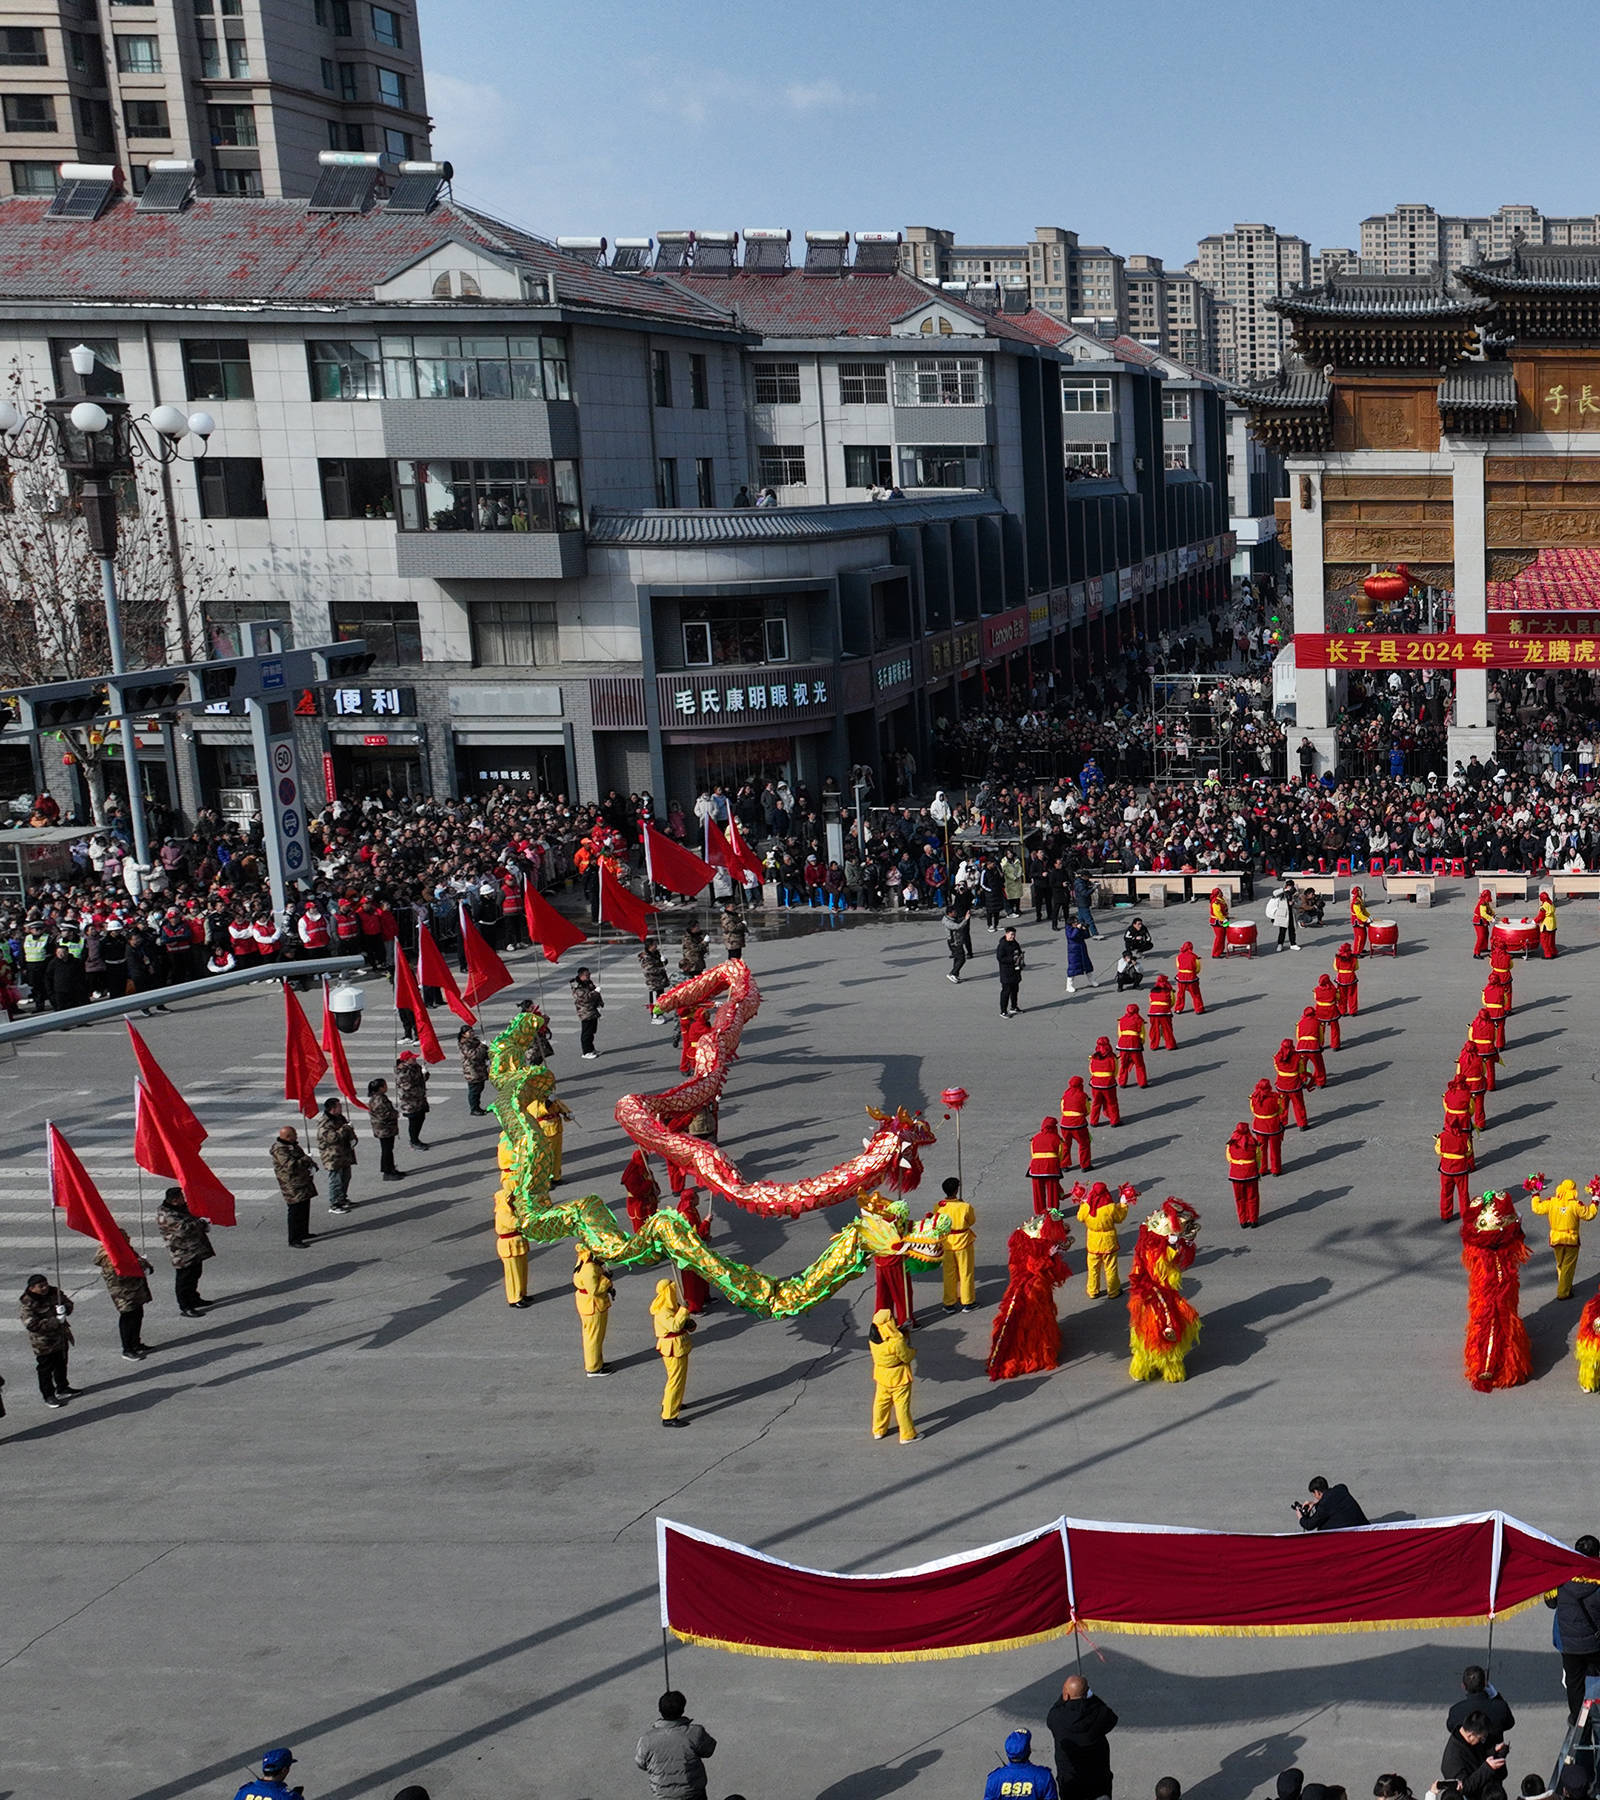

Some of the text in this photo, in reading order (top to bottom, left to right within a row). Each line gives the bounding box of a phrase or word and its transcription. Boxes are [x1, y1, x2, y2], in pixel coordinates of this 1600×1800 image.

[333, 688, 401, 715] 便利
[675, 681, 828, 715] 毛氏康明眼视光
[278, 753, 289, 767] 50
[1001, 1782, 1033, 1795] BSR
